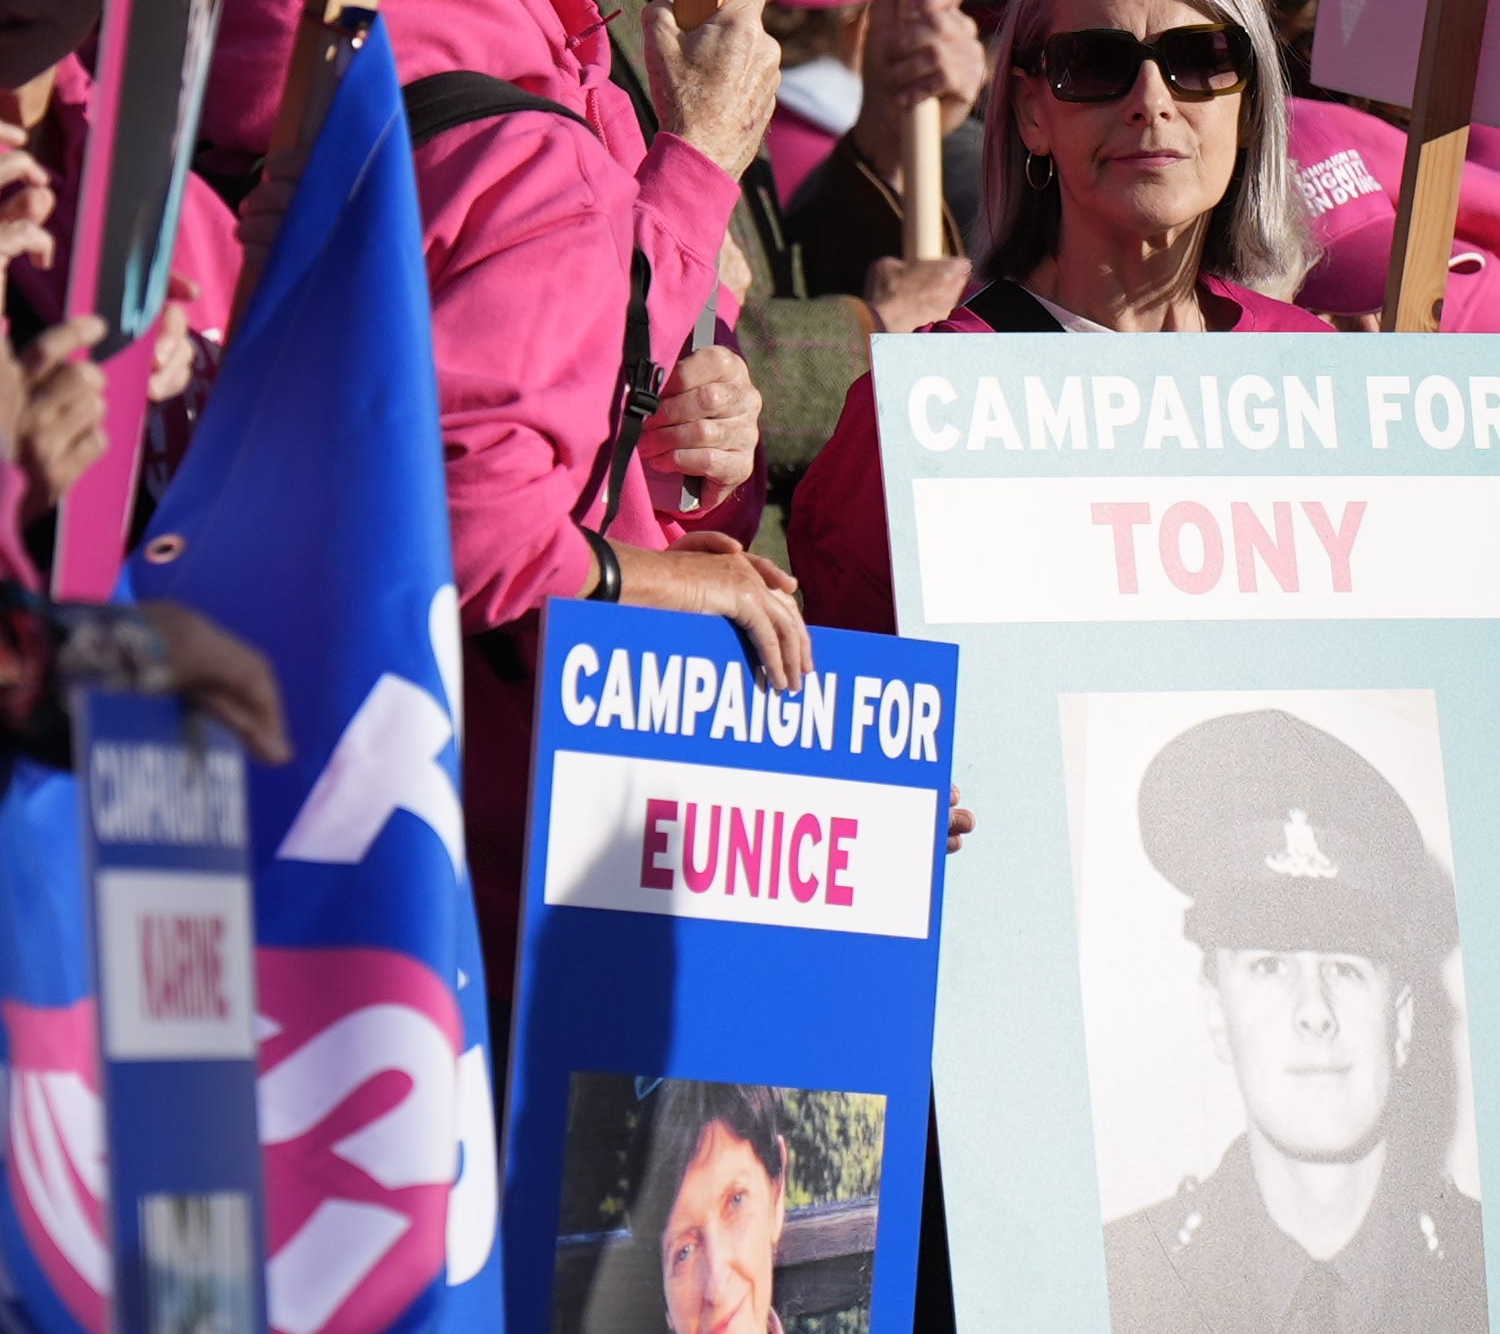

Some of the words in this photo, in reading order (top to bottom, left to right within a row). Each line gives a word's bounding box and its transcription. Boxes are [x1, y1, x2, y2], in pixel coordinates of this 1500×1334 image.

[906, 373, 1339, 452] CAMPAIGN
[1090, 499, 1369, 597] TONY
[561, 642, 838, 752] CAMPAIGN
[849, 674, 942, 763] FOR
[640, 797, 860, 908] EUNICE
